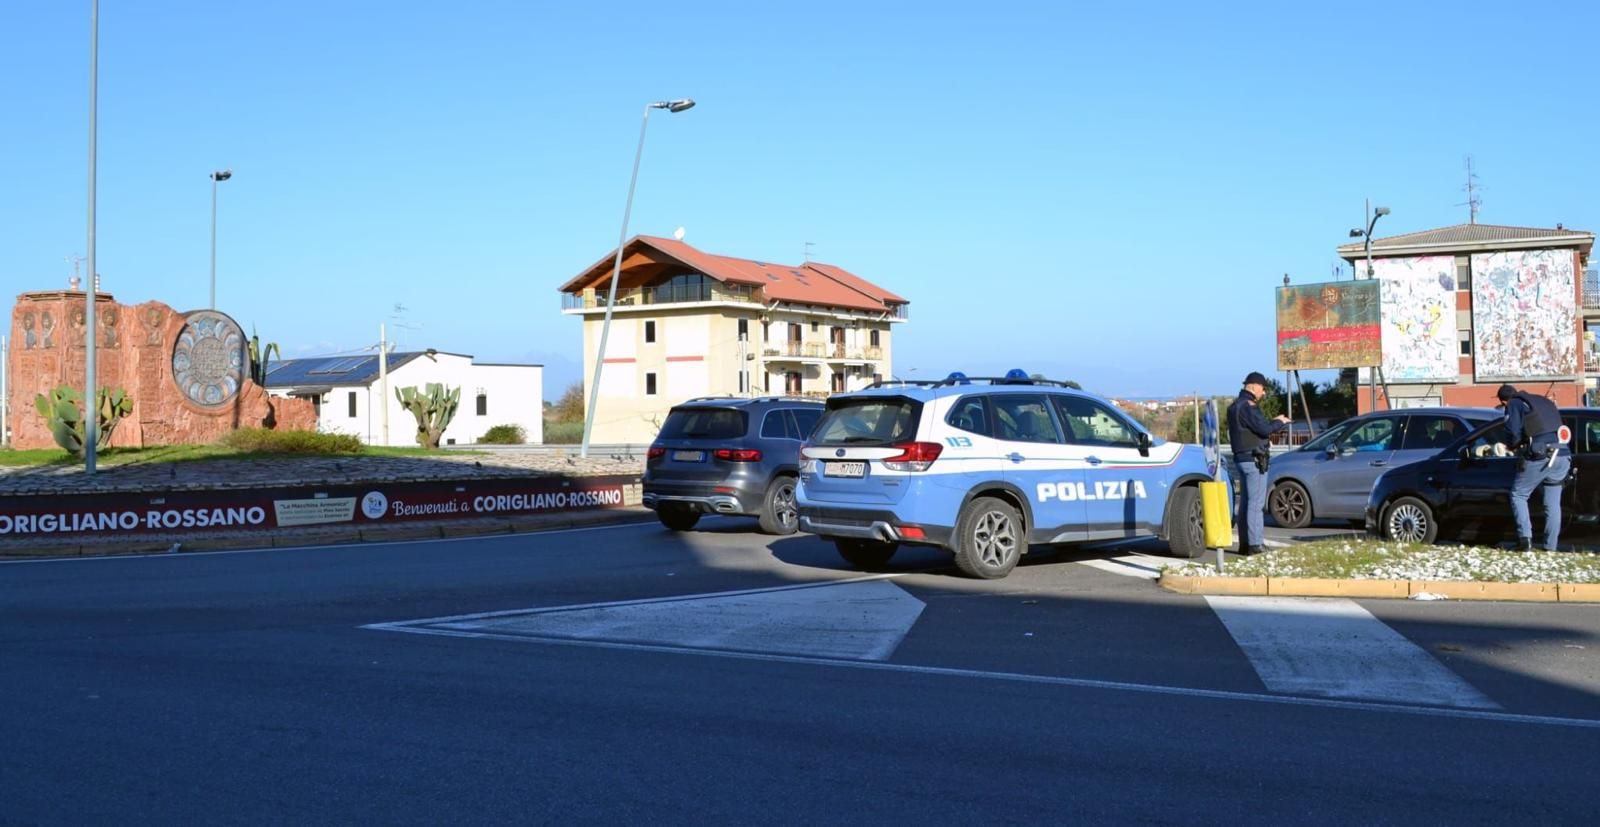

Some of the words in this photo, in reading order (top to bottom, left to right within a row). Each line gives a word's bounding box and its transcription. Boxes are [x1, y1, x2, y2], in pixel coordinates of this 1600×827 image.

[944, 437, 973, 448] 113
[1036, 480, 1148, 502] POLIZIA
[392, 499, 458, 516] Benvenuti
[460, 501, 470, 512] a
[473, 489, 621, 512] CORIGLIANO-ROSSANO
